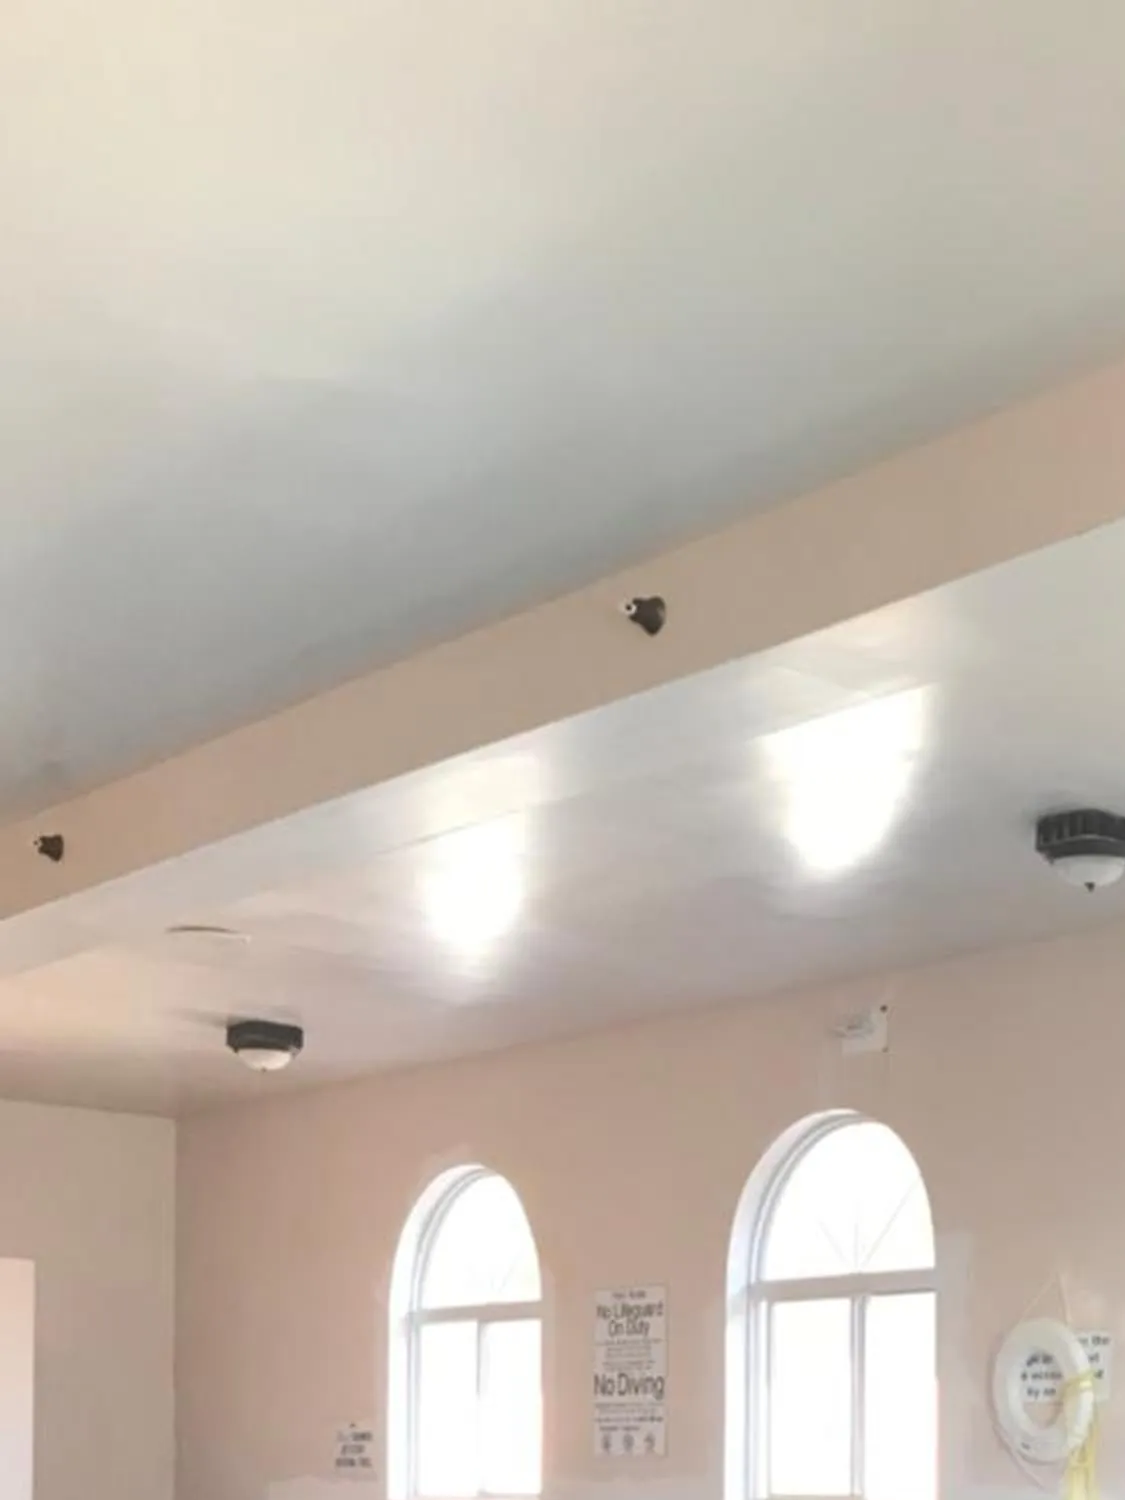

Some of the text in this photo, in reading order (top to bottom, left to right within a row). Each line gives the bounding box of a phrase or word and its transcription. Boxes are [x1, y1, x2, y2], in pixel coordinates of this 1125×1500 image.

[596, 1301, 664, 1320] No Lifeguard
[608, 1318, 650, 1338] On Duty
[593, 1373, 665, 1401] No Diving
